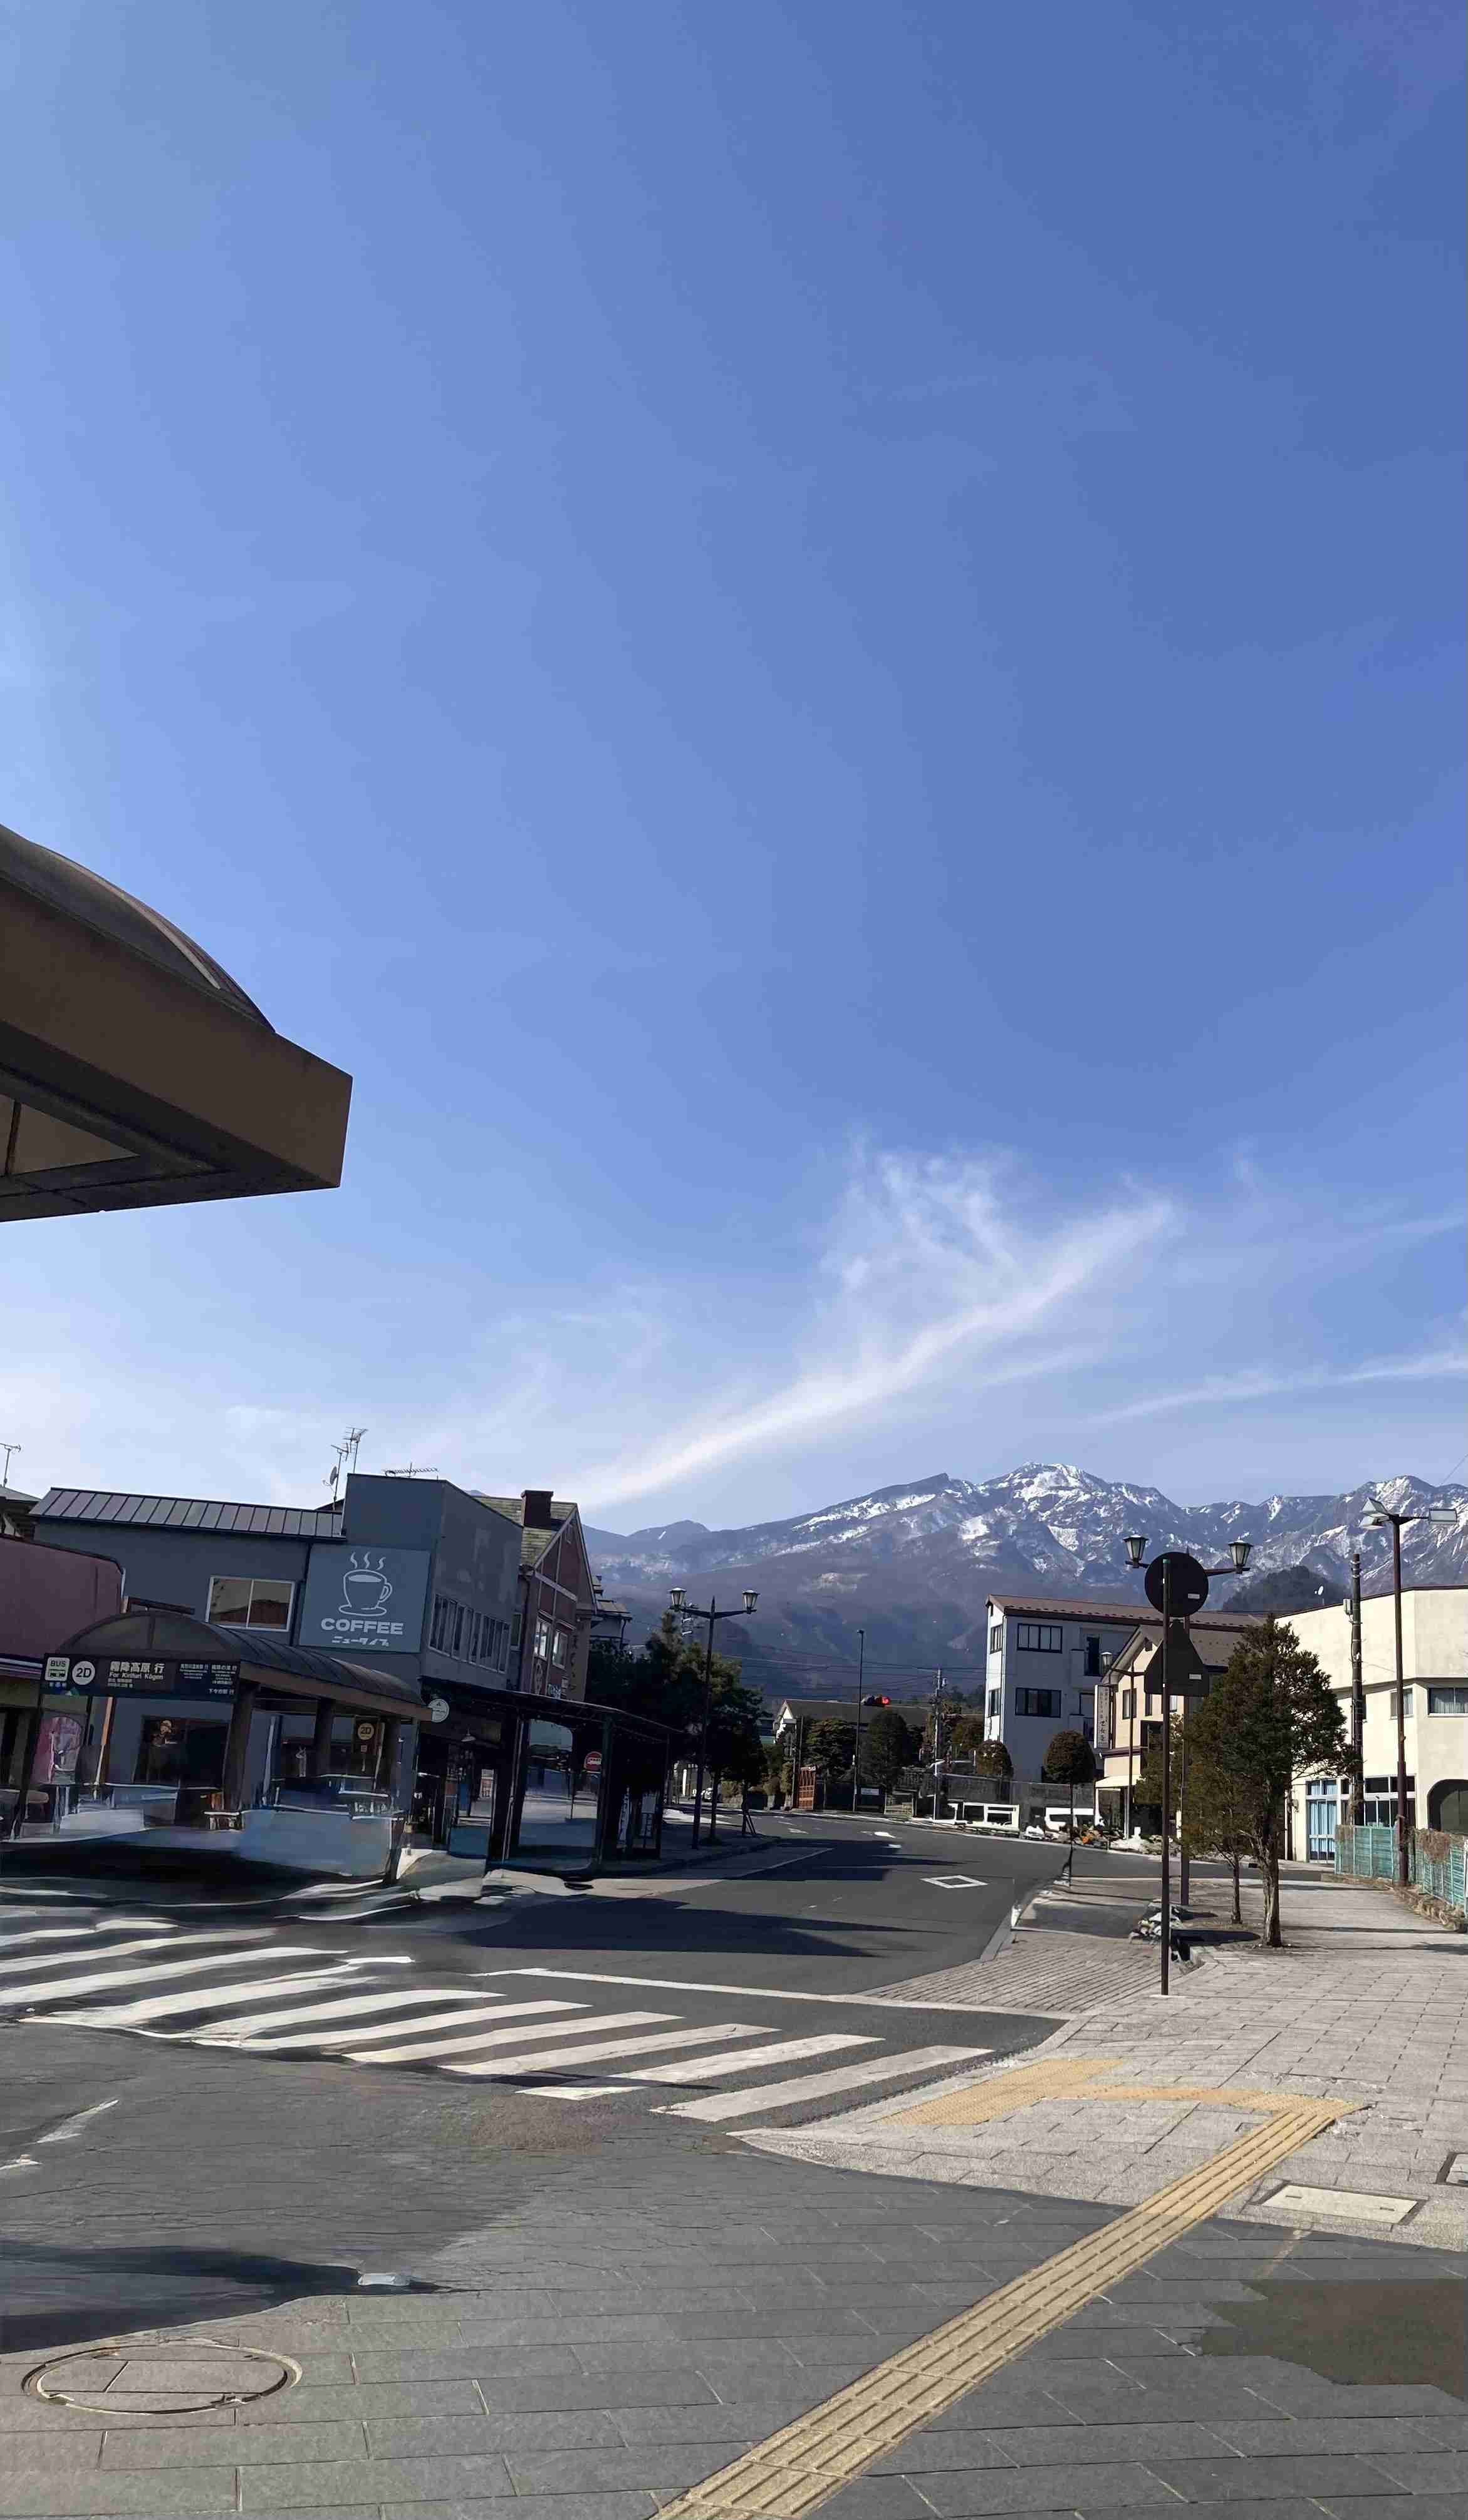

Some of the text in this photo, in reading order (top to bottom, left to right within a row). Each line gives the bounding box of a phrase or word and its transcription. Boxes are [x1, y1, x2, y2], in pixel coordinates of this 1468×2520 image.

[321, 1618, 403, 1635] COFFEE
[331, 1636, 389, 1646] ニュータイプ
[76, 1667, 92, 1678] 2D
[154, 1663, 165, 1674] 行
[360, 1726, 372, 1734] 2D
